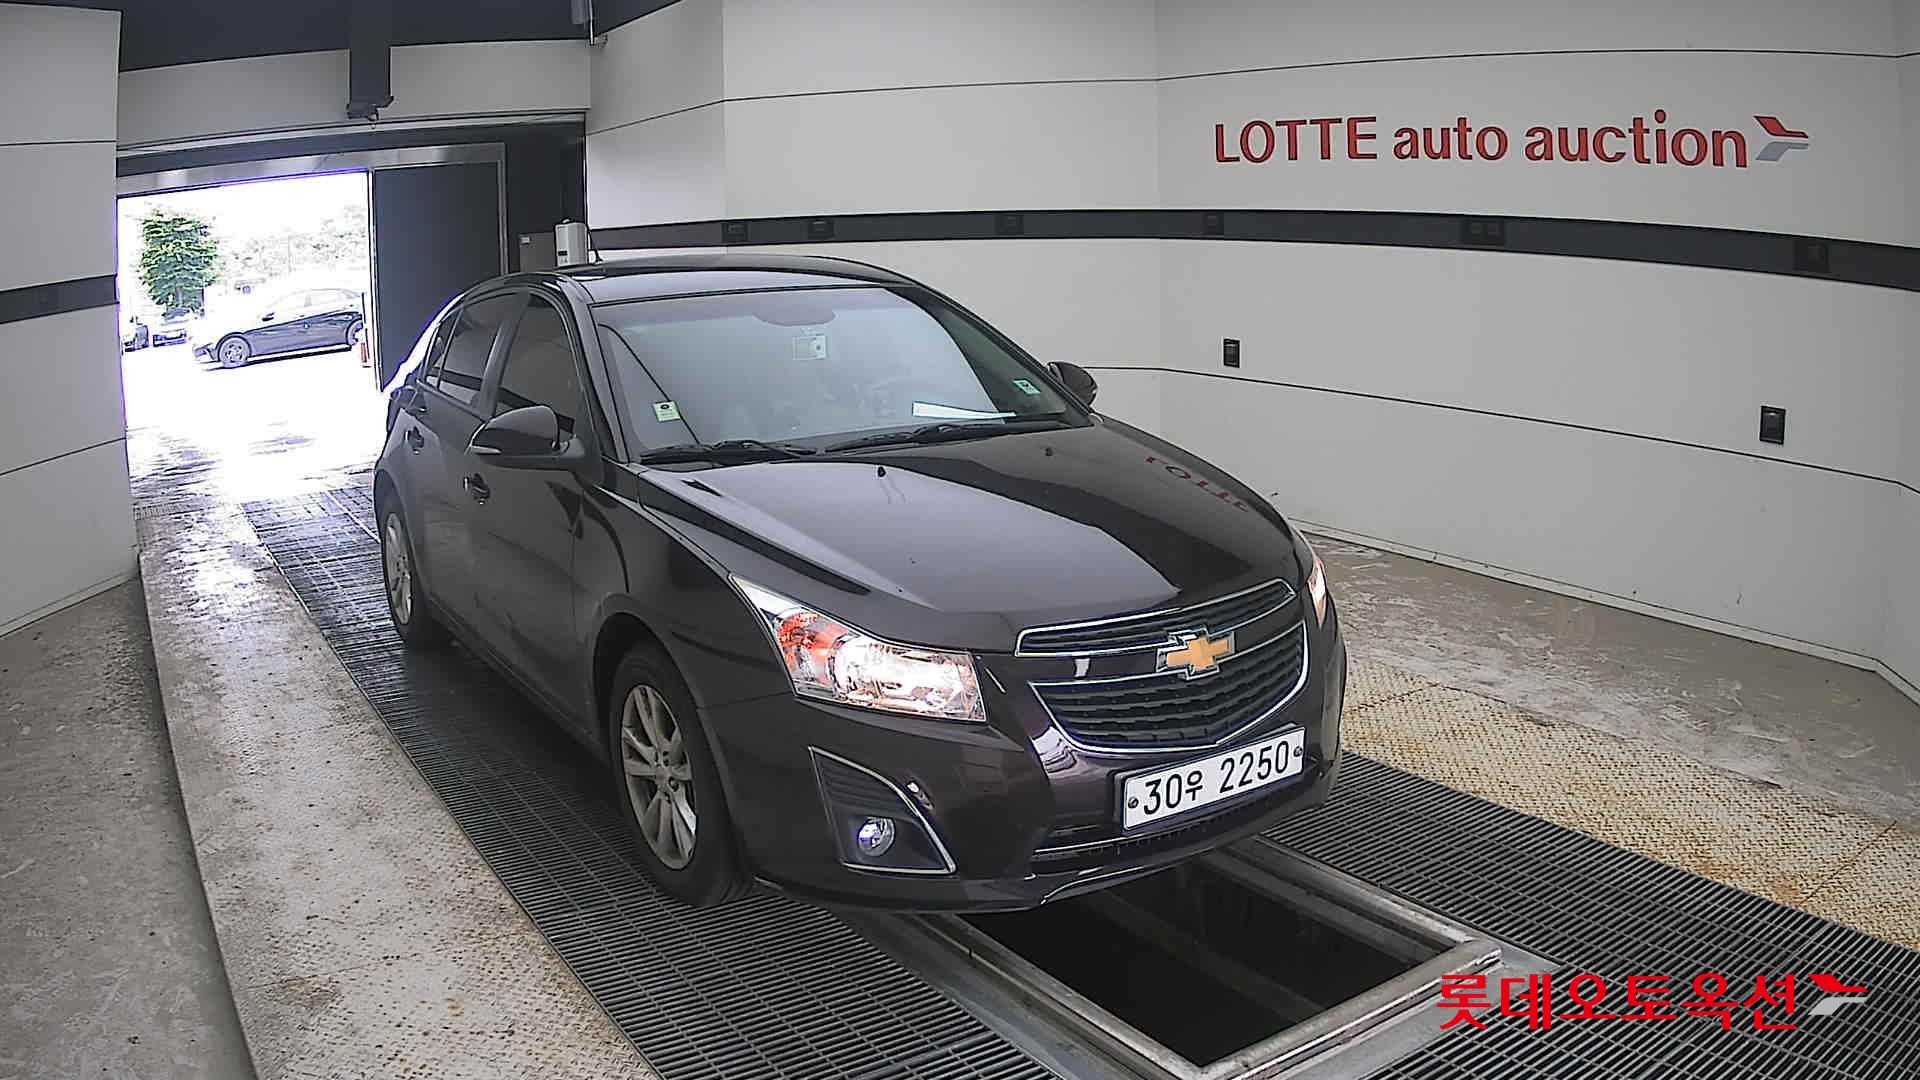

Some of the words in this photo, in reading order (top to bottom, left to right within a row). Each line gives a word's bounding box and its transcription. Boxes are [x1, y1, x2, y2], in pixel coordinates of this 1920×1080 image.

[1215, 117, 1377, 161] LOTTE
[1392, 117, 1511, 161] auto
[1524, 109, 1750, 168] auction
[1143, 769, 1204, 816] 30우
[1218, 740, 1290, 795] 2250
